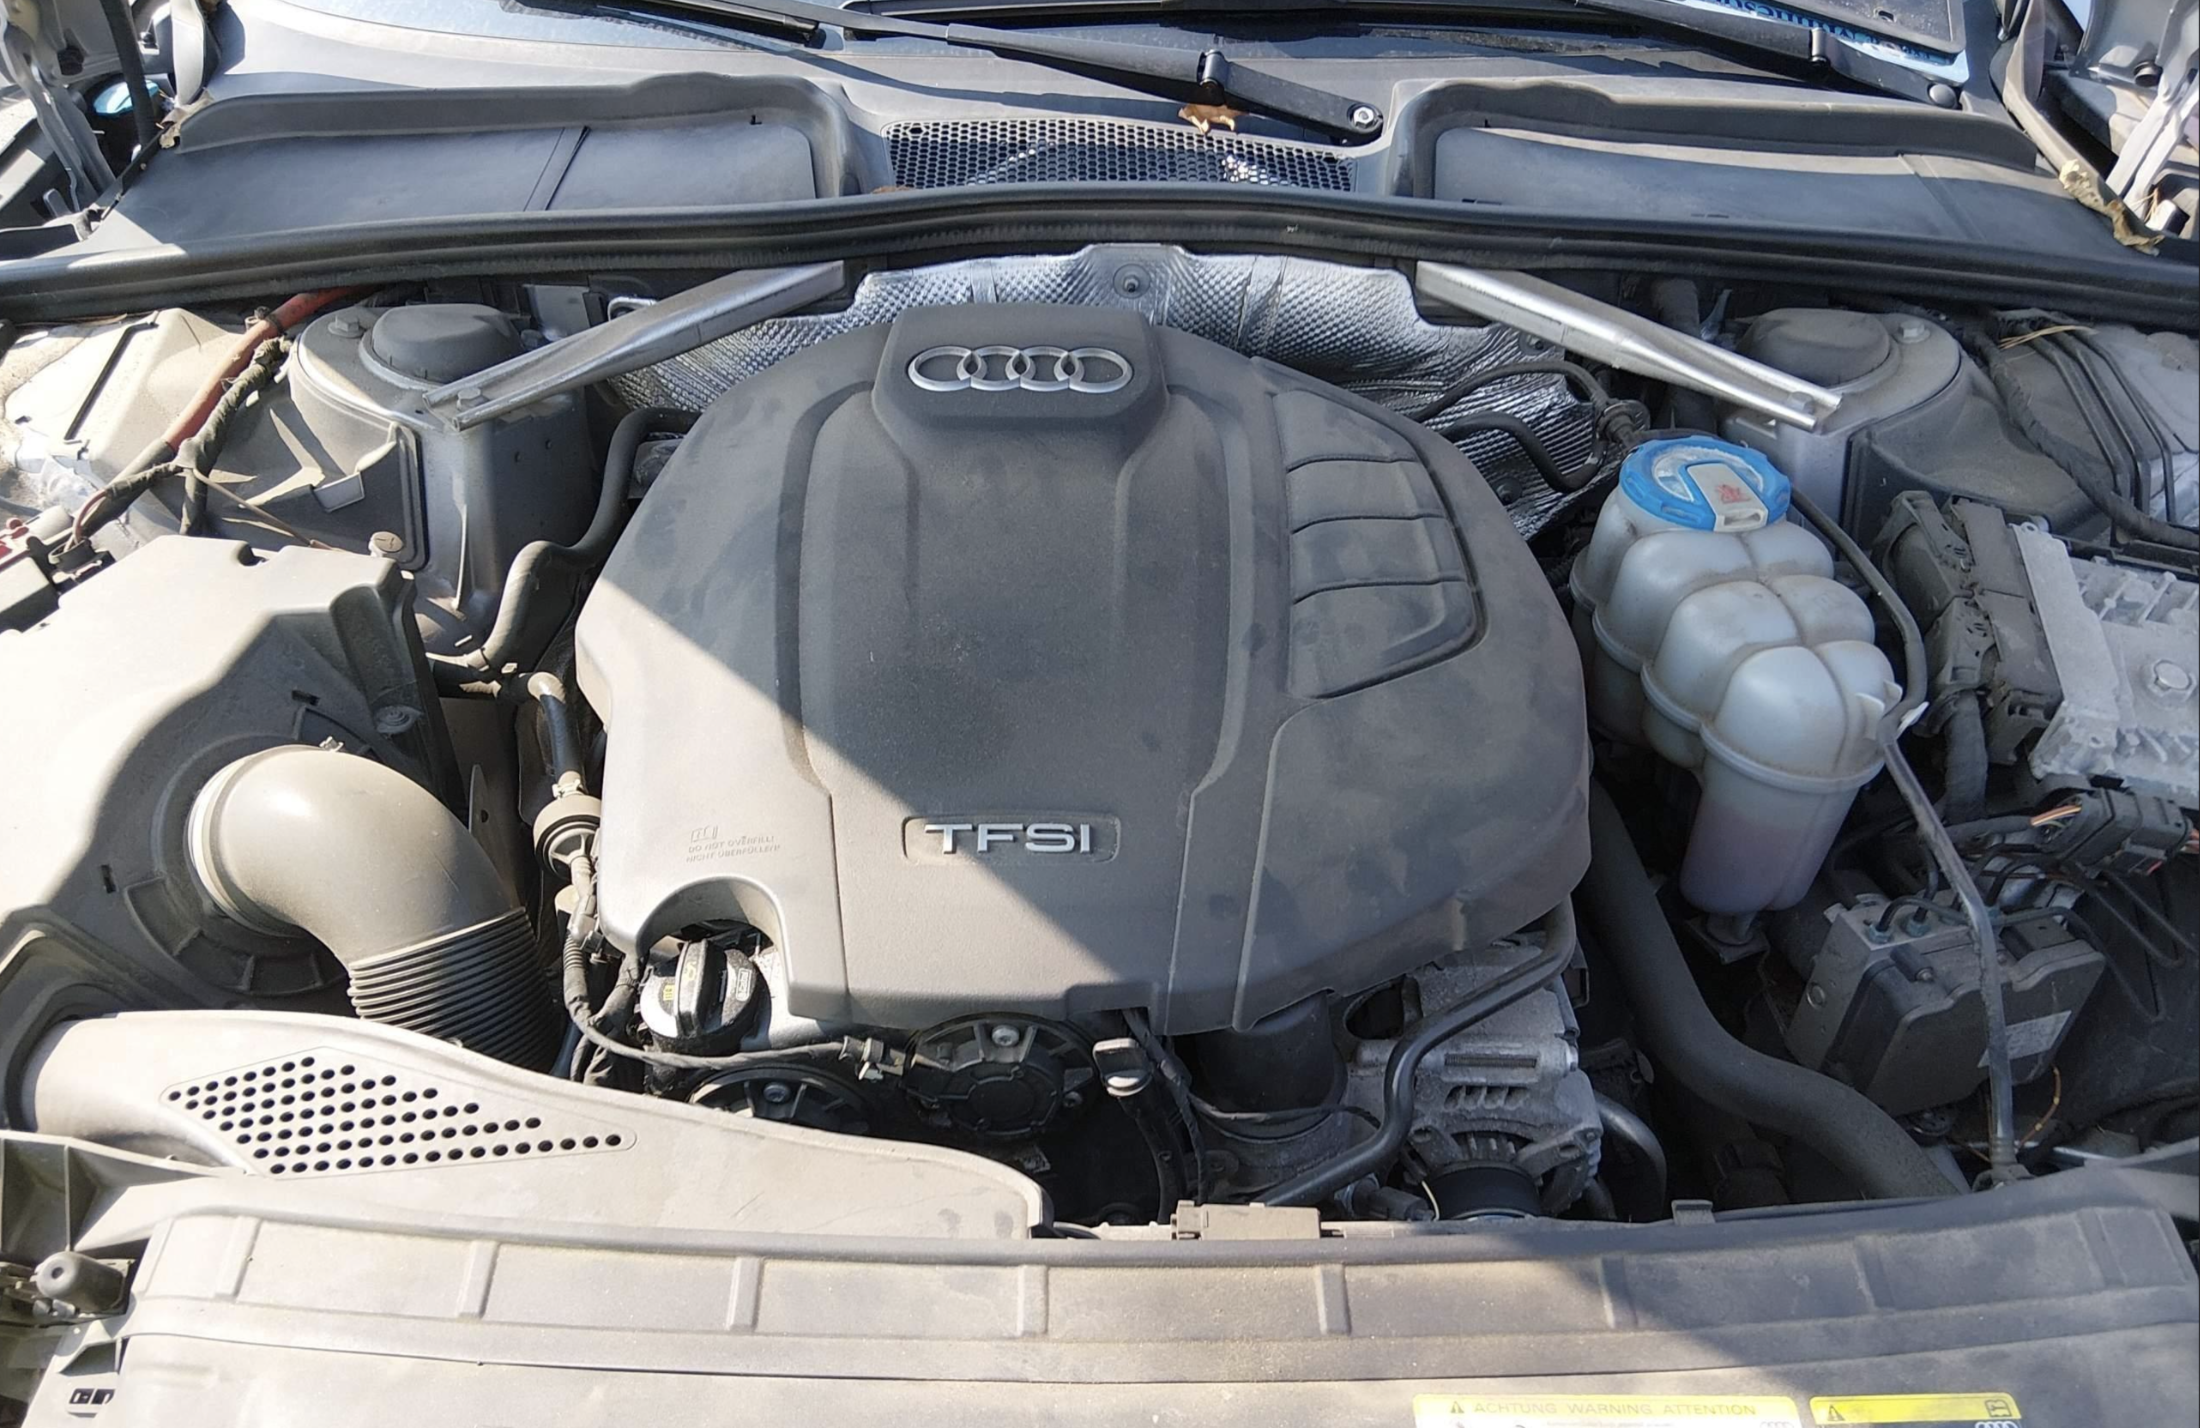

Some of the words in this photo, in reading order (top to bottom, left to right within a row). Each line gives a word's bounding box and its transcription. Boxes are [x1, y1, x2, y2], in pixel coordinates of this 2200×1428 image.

[688, 845, 702, 854] DO
[704, 840, 726, 851] NOT
[727, 835, 775, 848] OVERFILL!
[924, 823, 1091, 854] TFSI
[686, 852, 716, 863] NICHT
[1474, 1403, 1558, 1414] ACHTUNG
[1567, 1403, 1653, 1414] WARNING
[1663, 1403, 1757, 1416] ATTENTION
